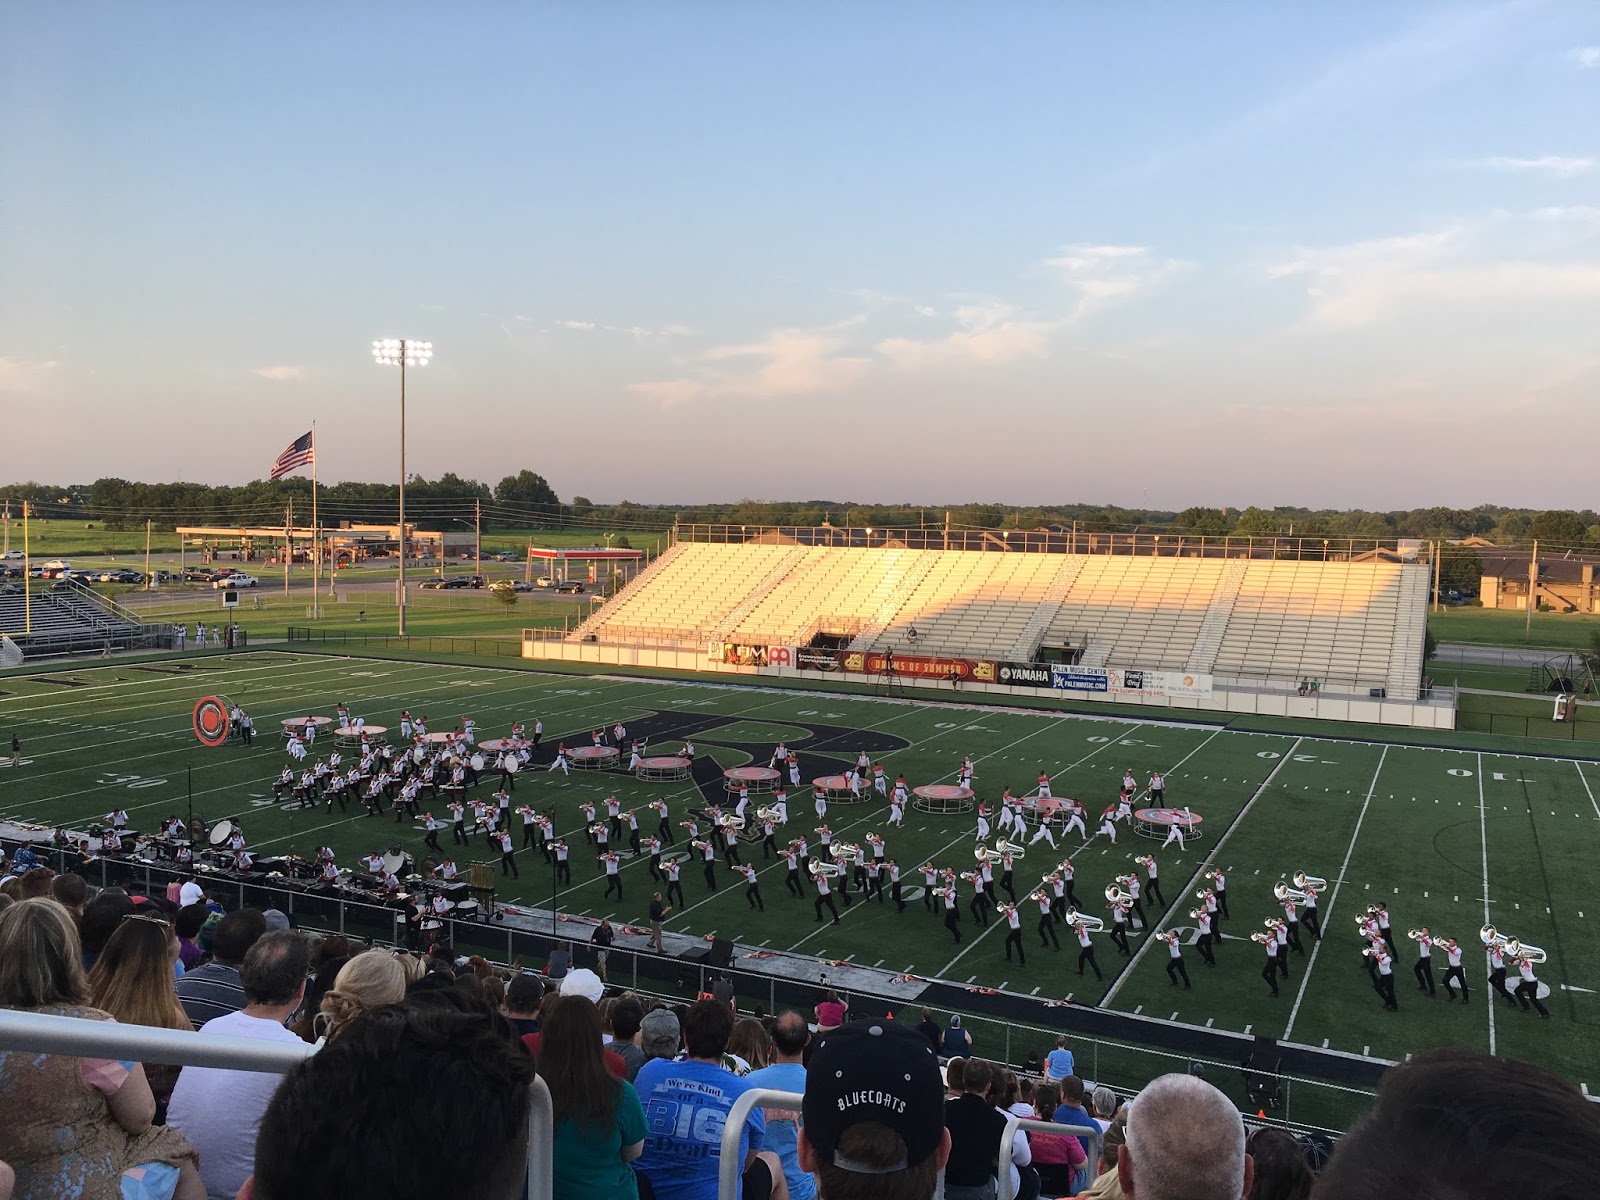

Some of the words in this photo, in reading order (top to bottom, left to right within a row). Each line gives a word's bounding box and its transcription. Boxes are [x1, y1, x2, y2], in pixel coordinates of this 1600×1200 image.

[875, 660, 905, 670] DRMS
[909, 662, 919, 671] OF
[1052, 665, 1068, 673] PALEN
[1070, 667, 1086, 675] MUSIC
[1087, 668, 1107, 676] CENTER
[1011, 668, 1049, 682] YAMAHA
[1064, 680, 1106, 690] PALENMUSIC.COM
[667, 1079, 695, 1090] We're
[678, 1093, 694, 1102] of
[696, 1096, 704, 1105] a
[838, 1090, 906, 1113] BLUECOATS
[646, 1099, 728, 1144] BIG
